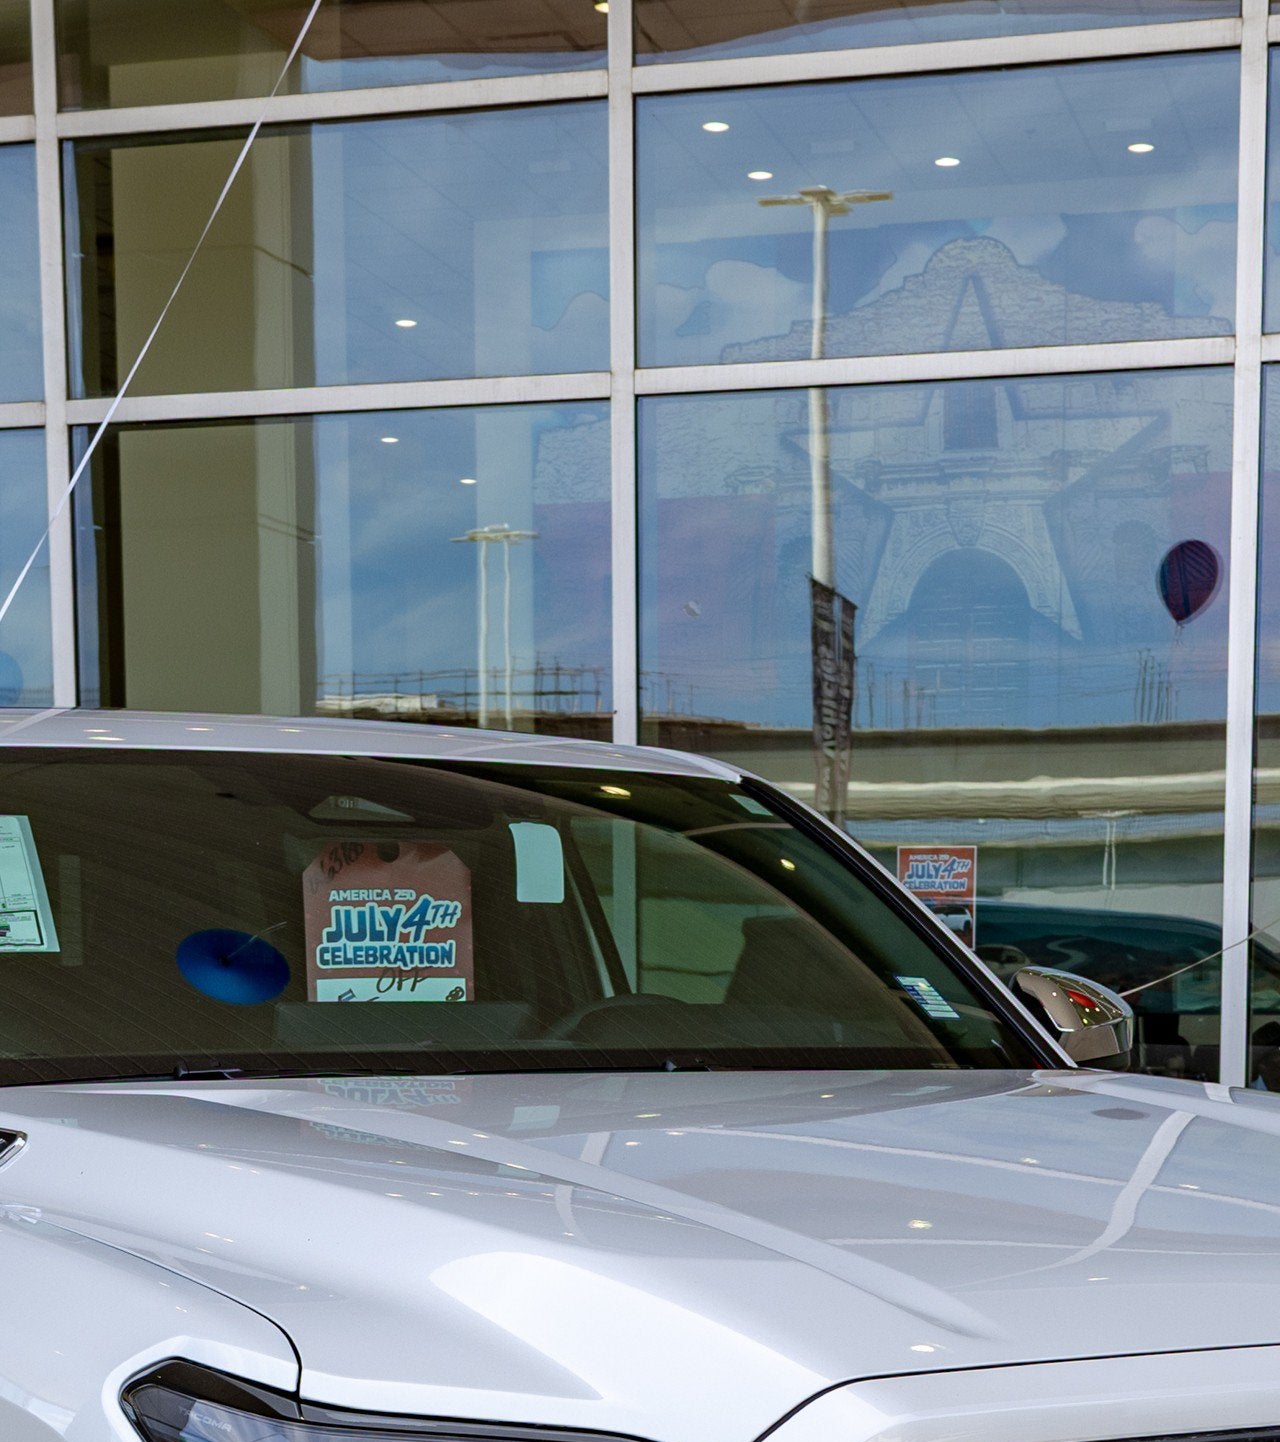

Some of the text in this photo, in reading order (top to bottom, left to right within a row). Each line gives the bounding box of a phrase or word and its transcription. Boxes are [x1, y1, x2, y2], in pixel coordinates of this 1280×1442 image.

[906, 857, 970, 880] JULY 4TH
[329, 889, 416, 902] AMERICA 250
[903, 879, 966, 891] CELEBRATION
[324, 895, 460, 943] JULY 4TH
[318, 942, 454, 968] CELEBRATION
